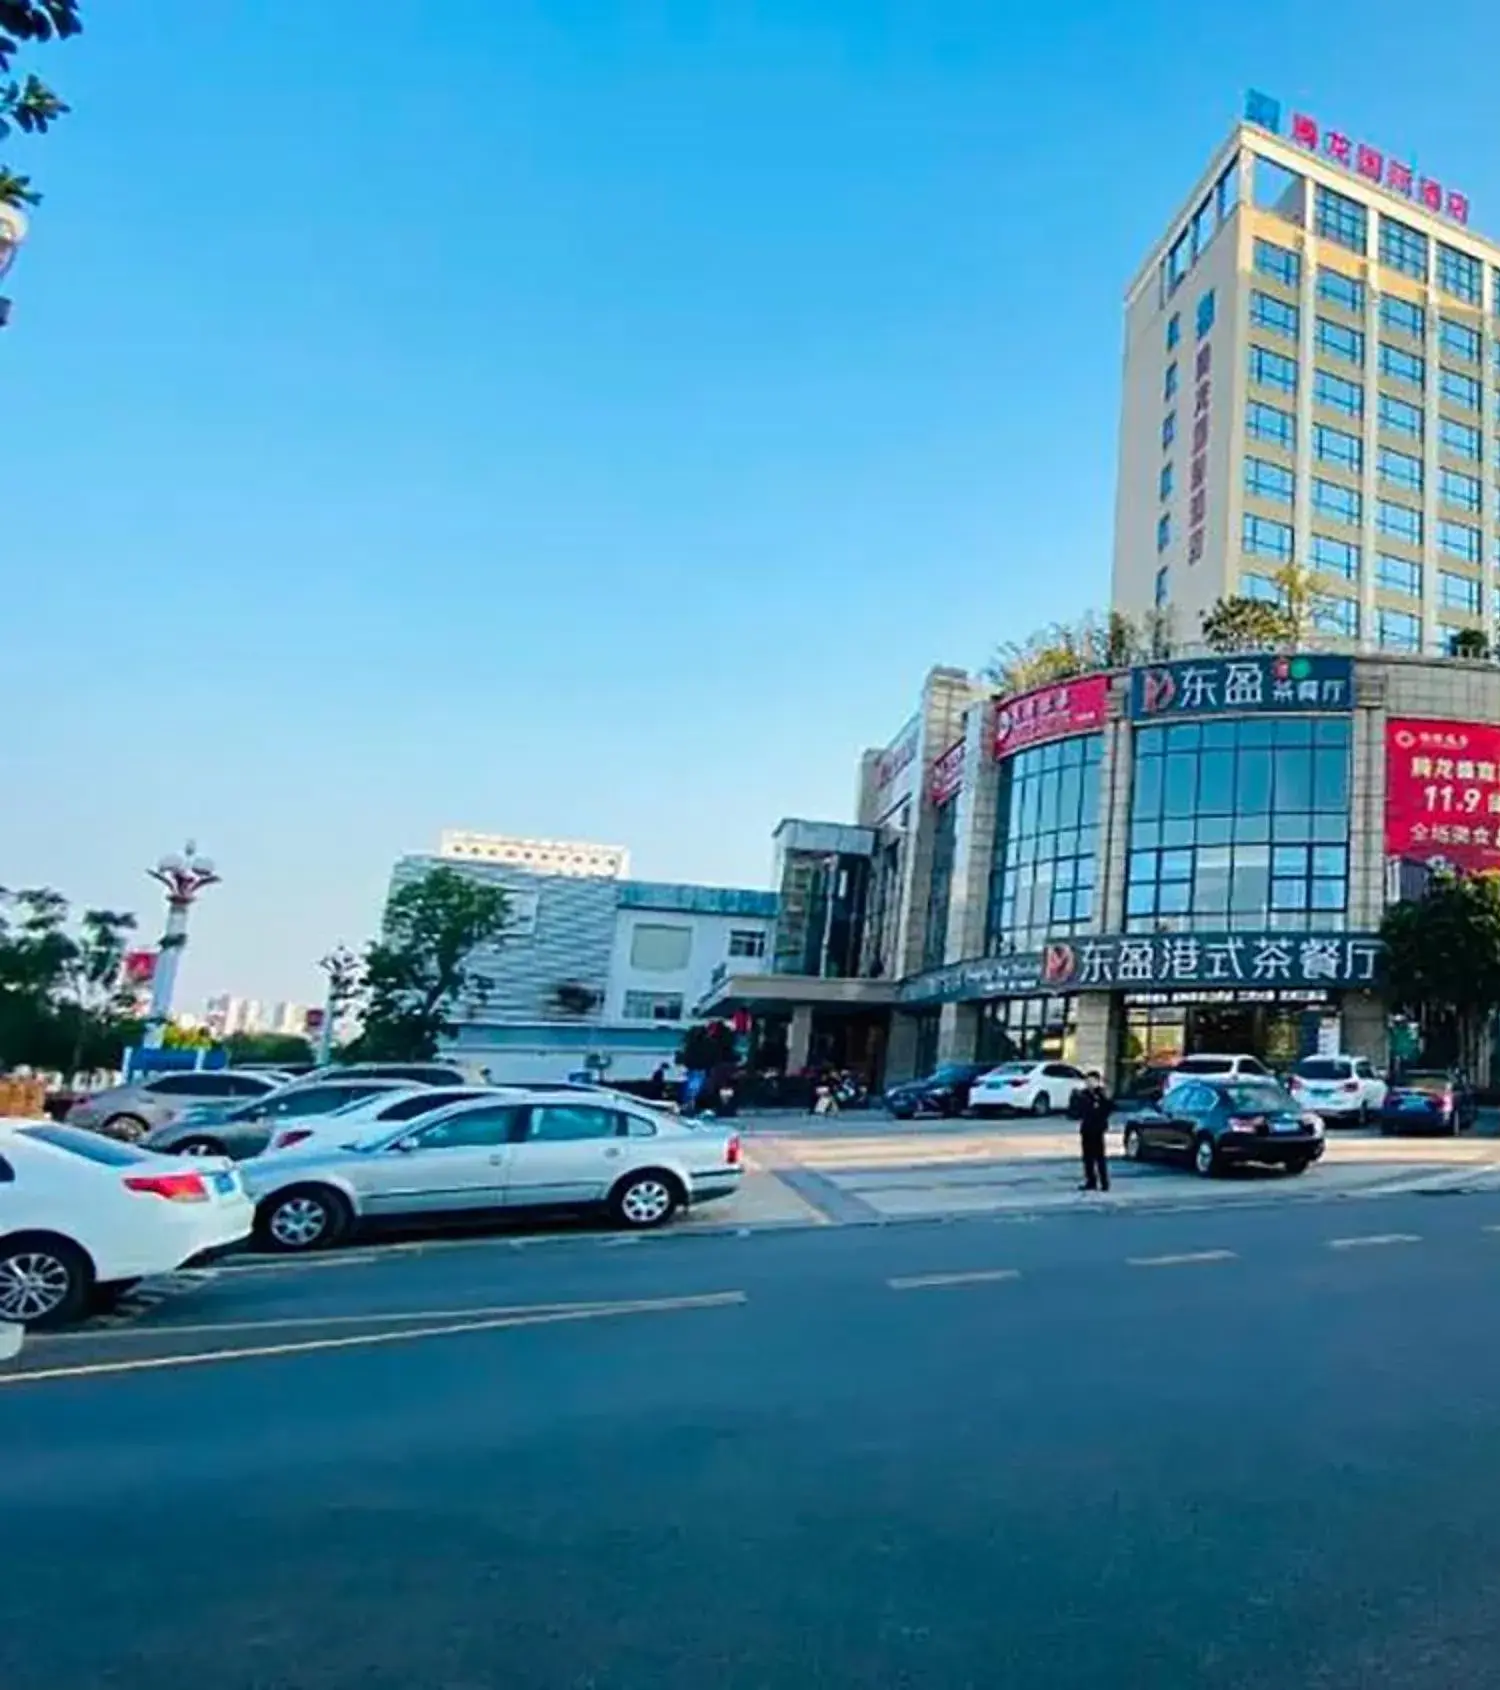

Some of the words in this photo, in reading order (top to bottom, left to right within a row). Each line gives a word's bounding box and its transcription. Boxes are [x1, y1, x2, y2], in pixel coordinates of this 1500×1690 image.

[1180, 662, 1263, 708] 东盈
[1272, 679, 1346, 703] 茶餐厅
[1424, 784, 1481, 813] 11.9
[1080, 936, 1379, 982] 东盈港式茶餐厅
